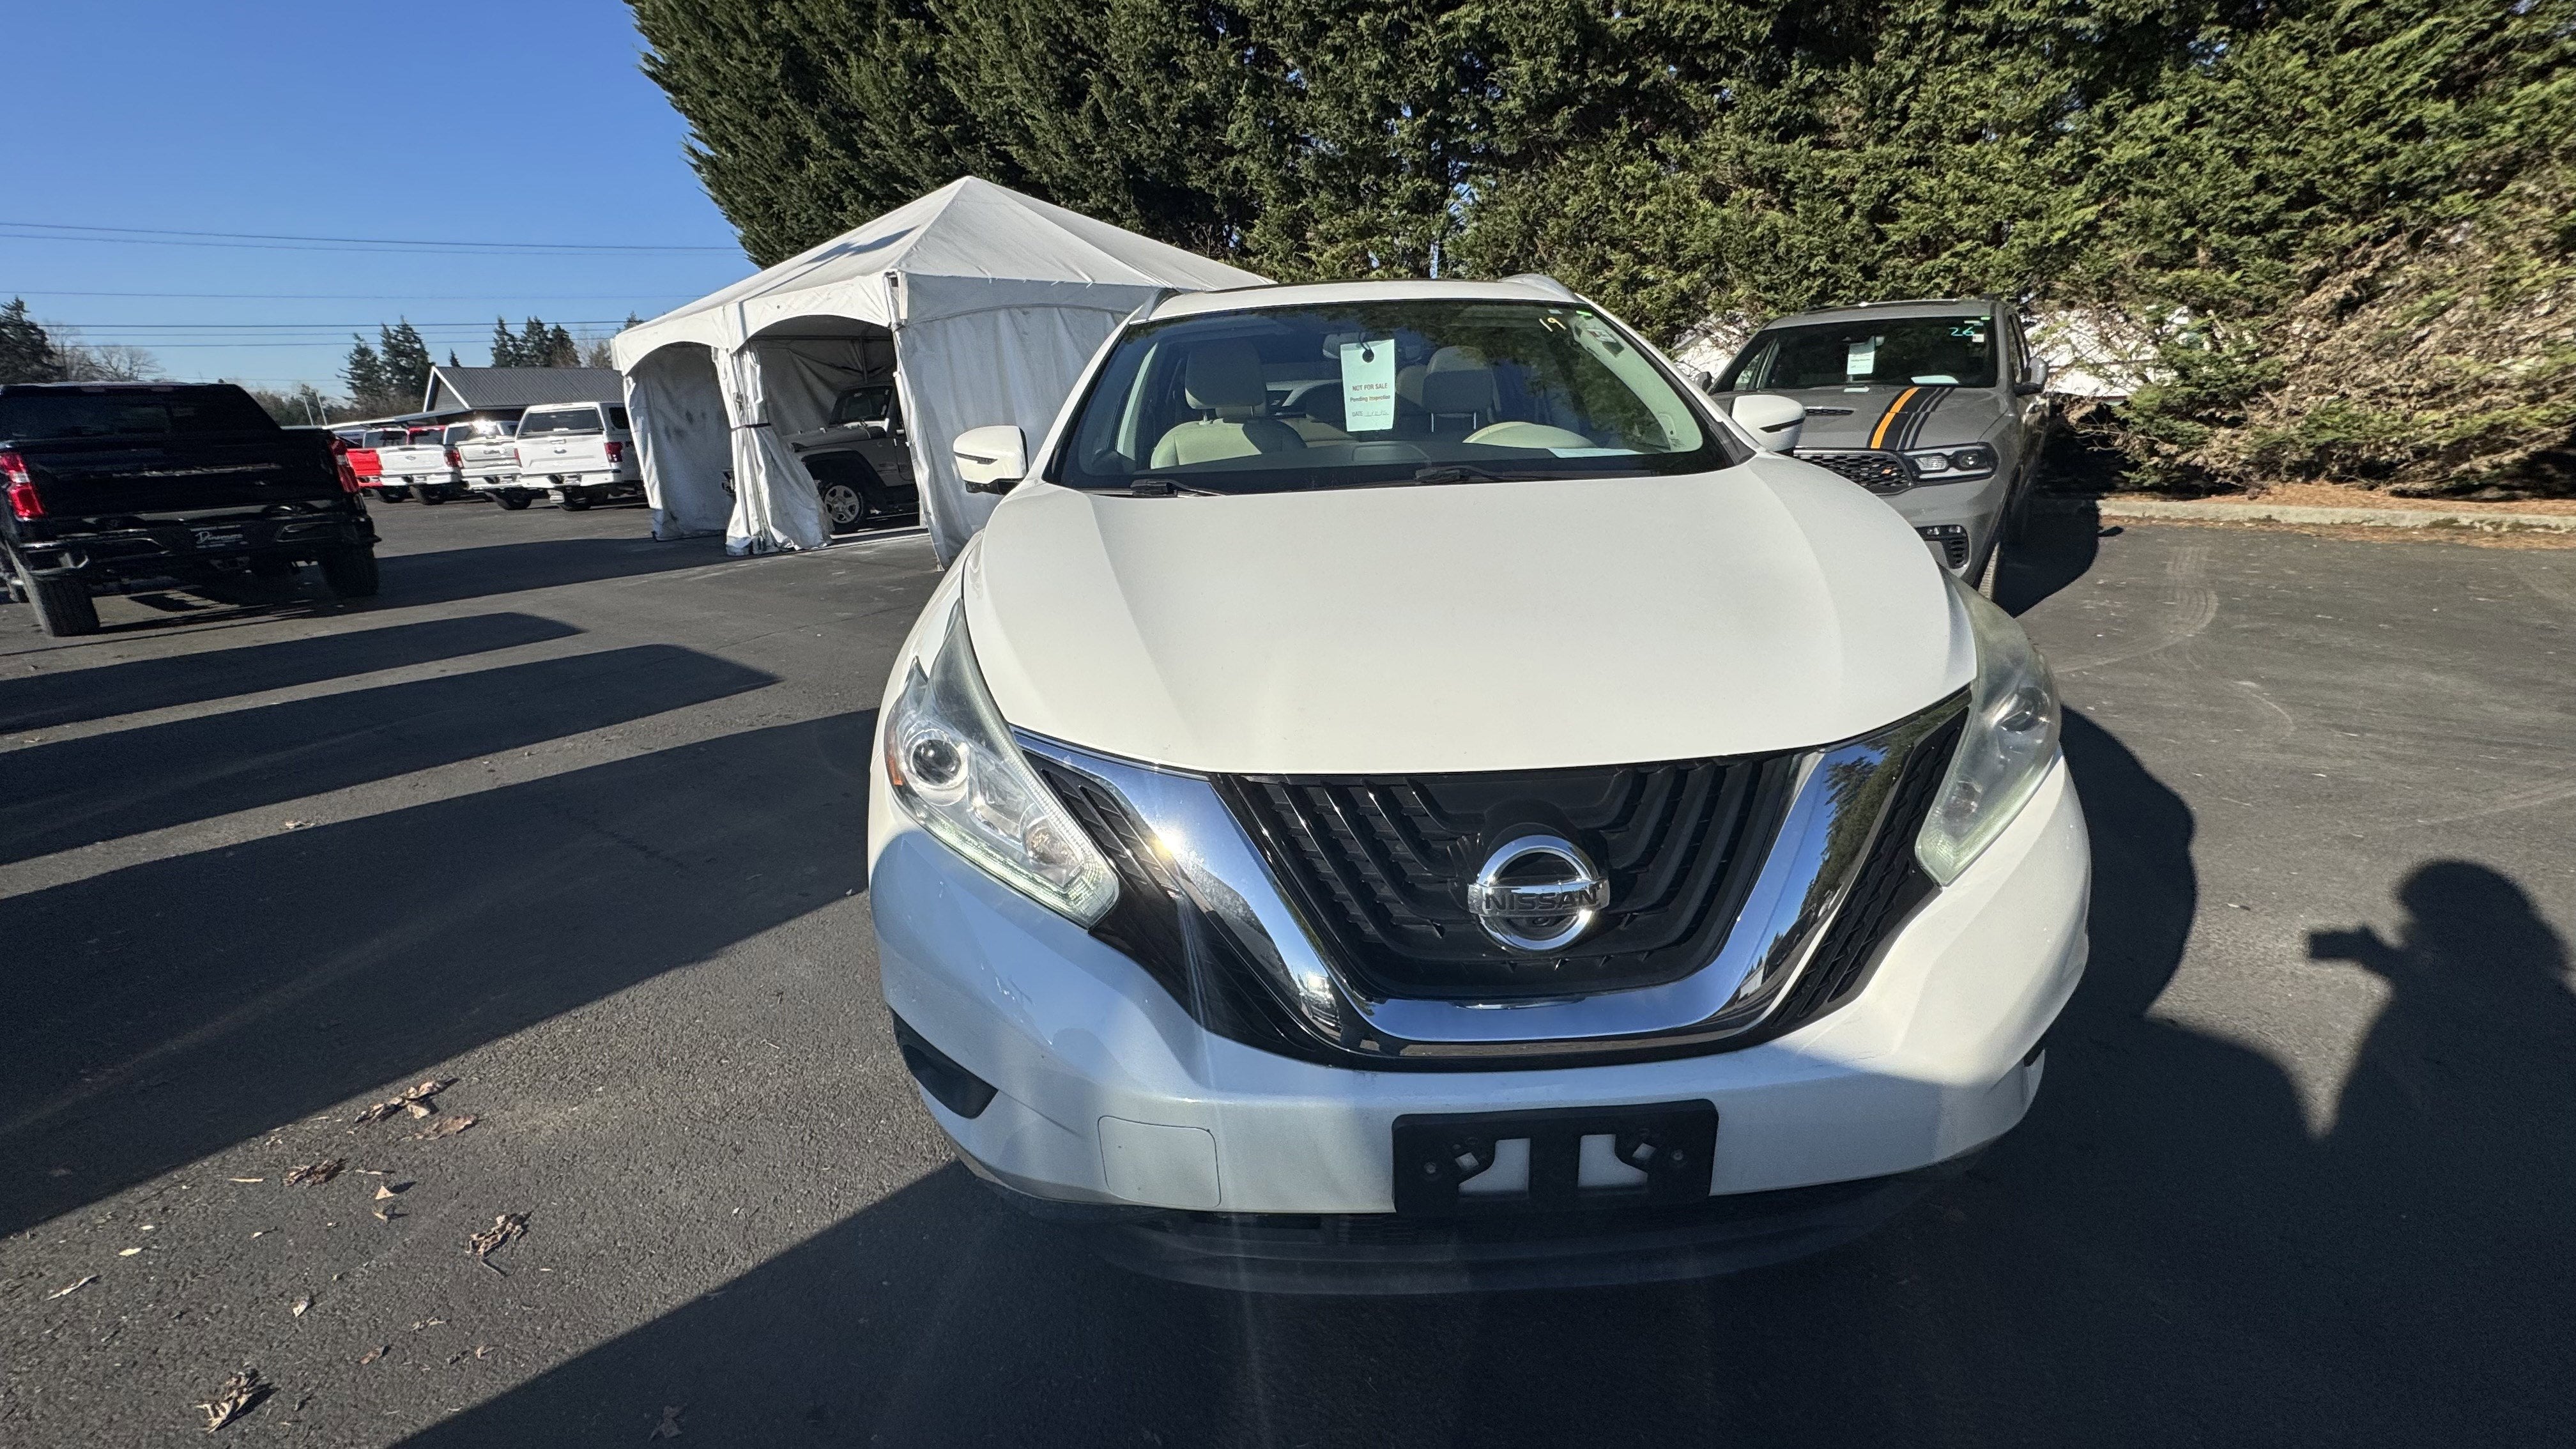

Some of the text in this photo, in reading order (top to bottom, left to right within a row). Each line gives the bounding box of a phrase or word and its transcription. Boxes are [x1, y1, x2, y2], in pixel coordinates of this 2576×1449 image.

[1538, 317, 1567, 332] 19
[1949, 326, 1975, 337] 26
[1483, 885, 1599, 911] NISSAN
